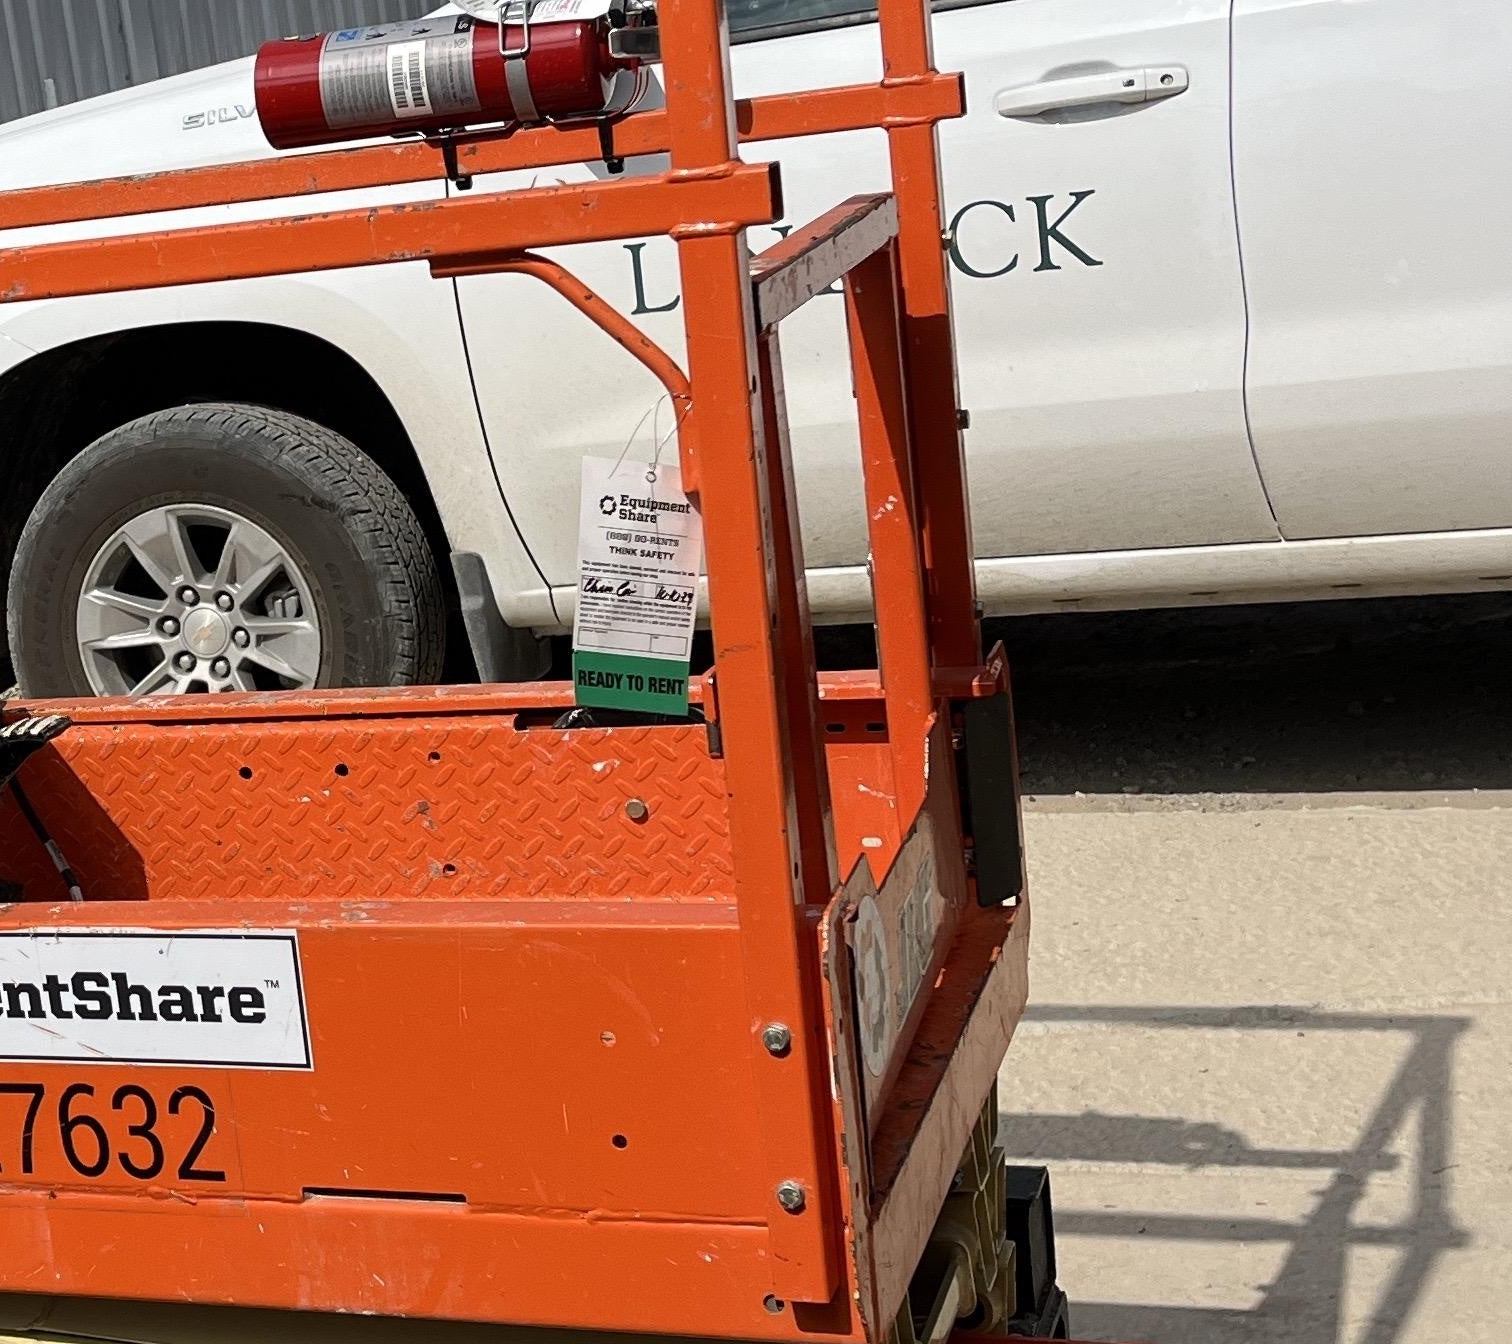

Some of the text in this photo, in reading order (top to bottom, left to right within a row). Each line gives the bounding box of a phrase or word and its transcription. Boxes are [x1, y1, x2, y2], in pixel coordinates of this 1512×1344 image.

[619, 494, 691, 515] Equipment
[618, 509, 657, 524] Share
[609, 545, 675, 561] THINK SAFETY
[578, 669, 685, 696] READY TO RENT
